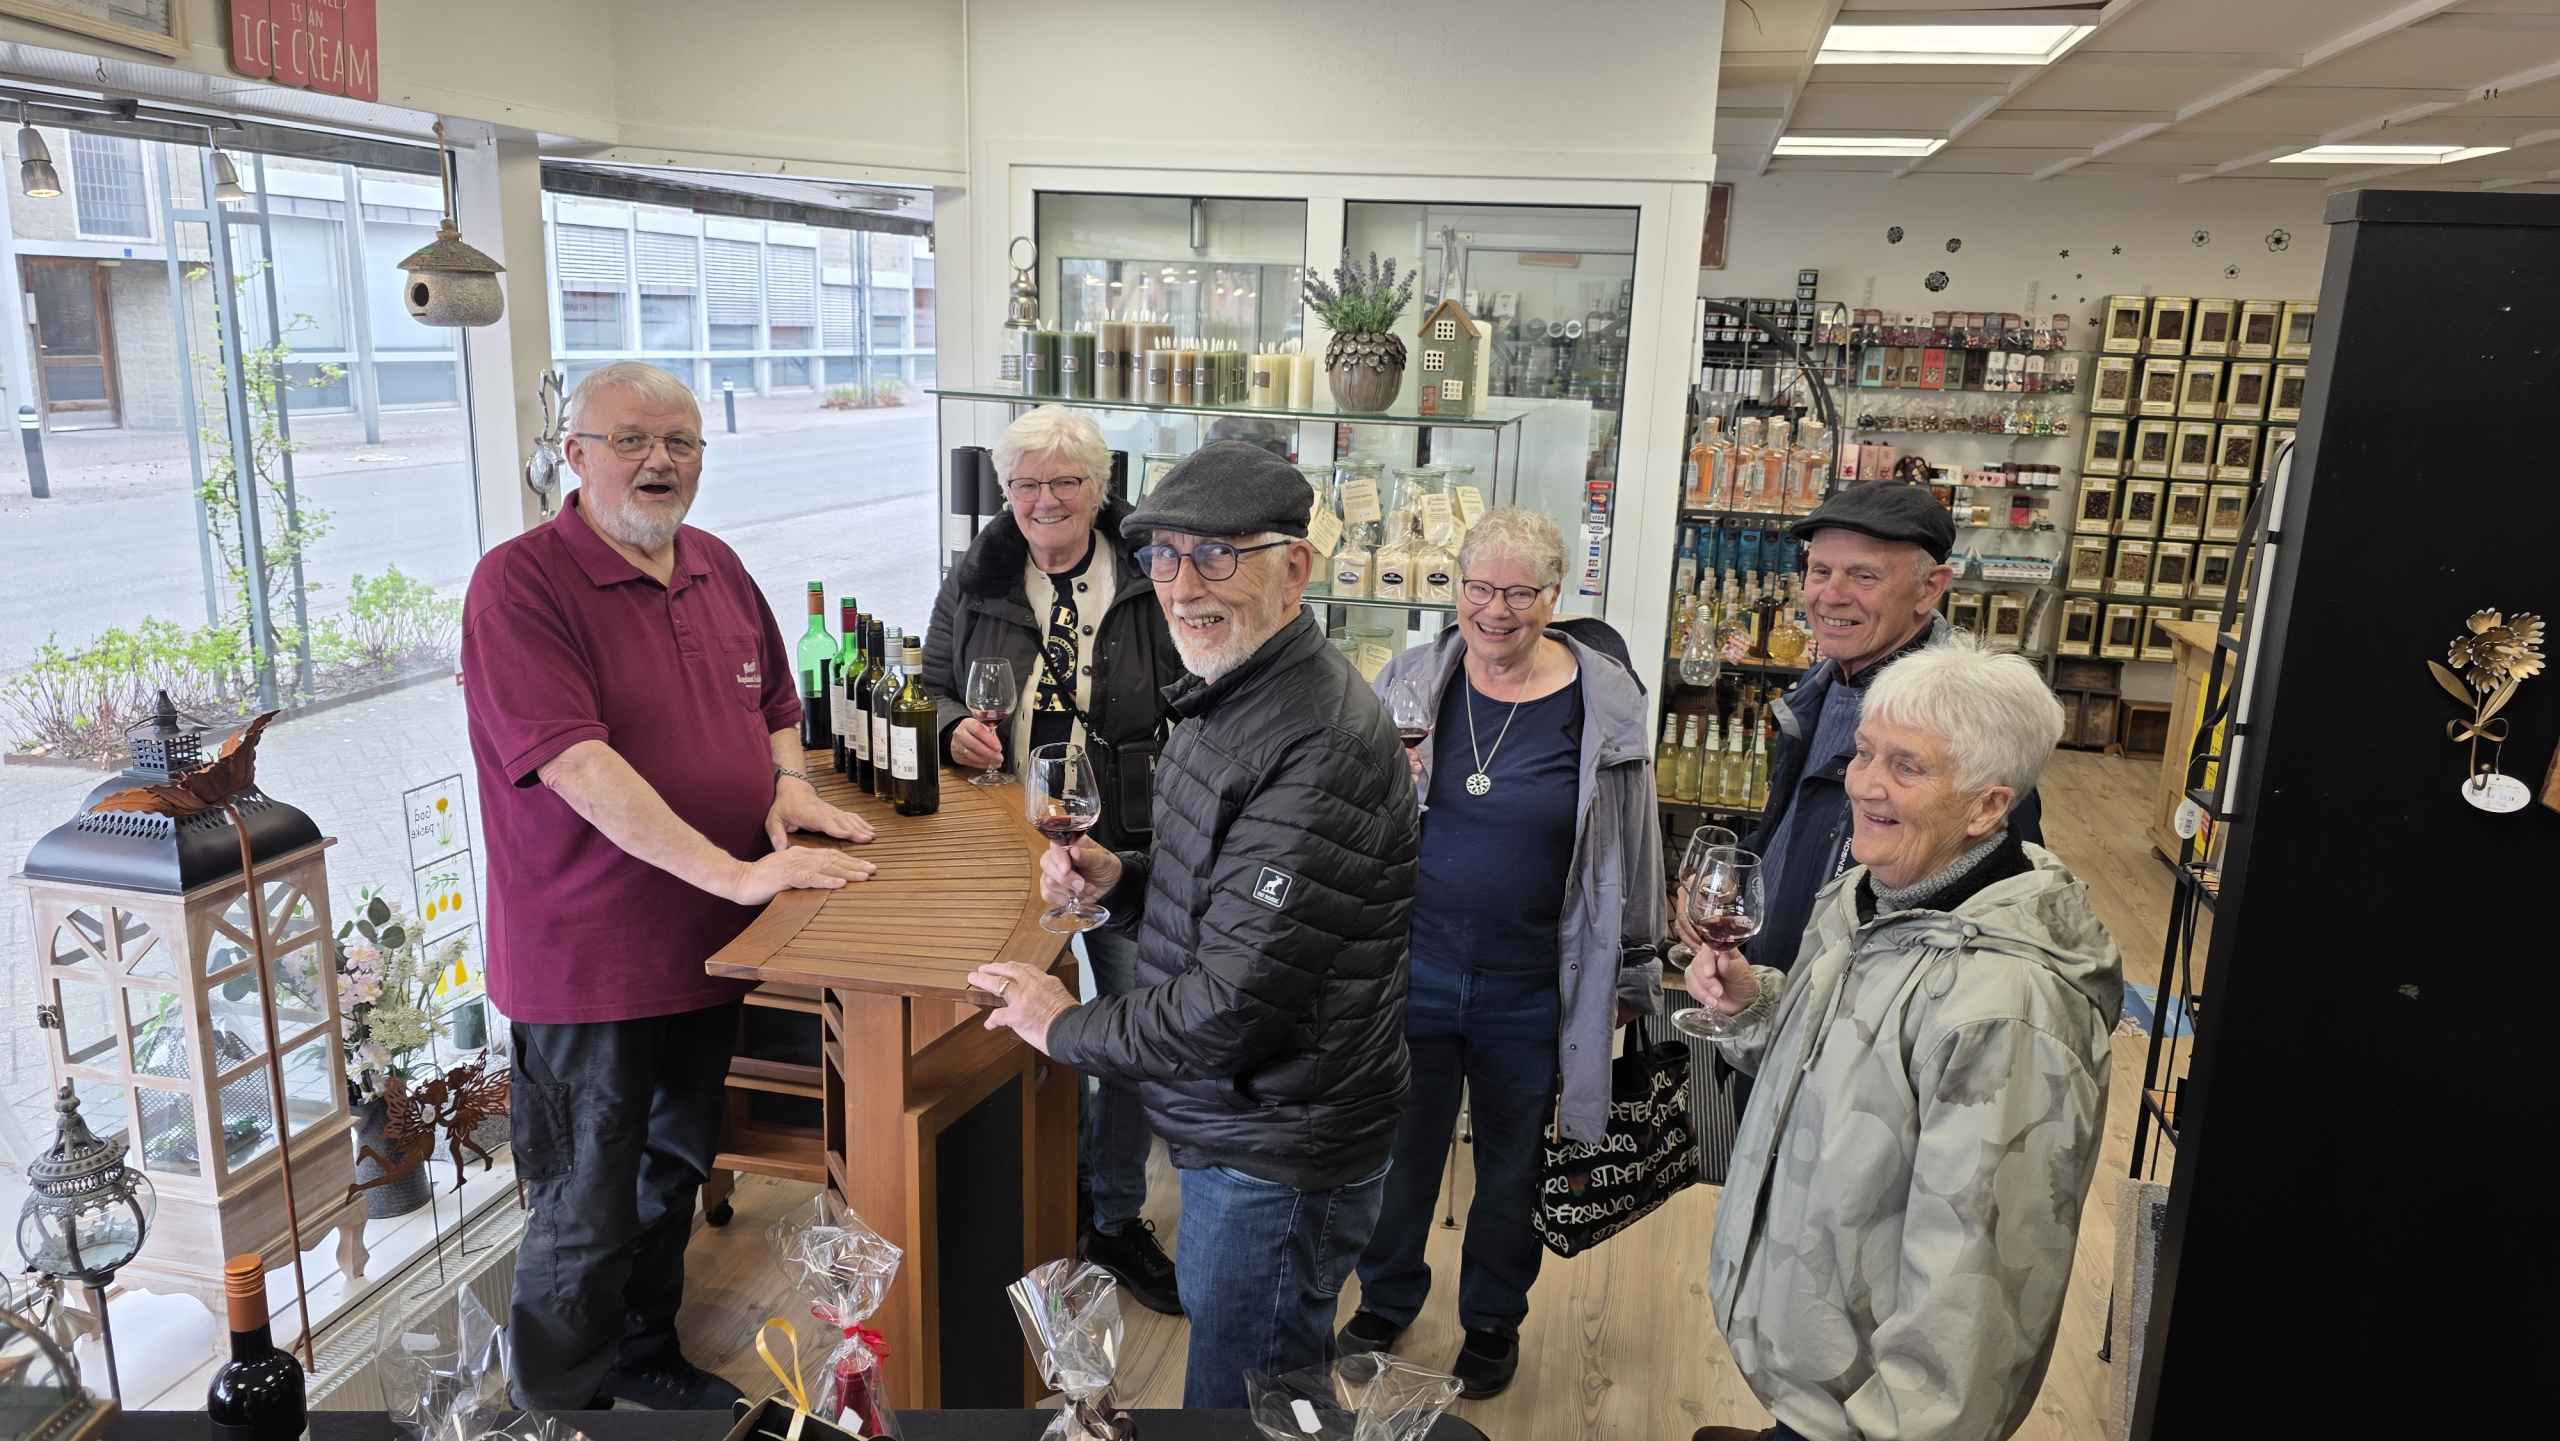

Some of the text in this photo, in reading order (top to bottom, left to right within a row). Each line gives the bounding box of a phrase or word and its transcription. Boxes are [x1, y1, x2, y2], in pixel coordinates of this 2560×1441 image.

[290, 3, 324, 28] IS AN
[239, 13, 372, 95] ICE CREAM
